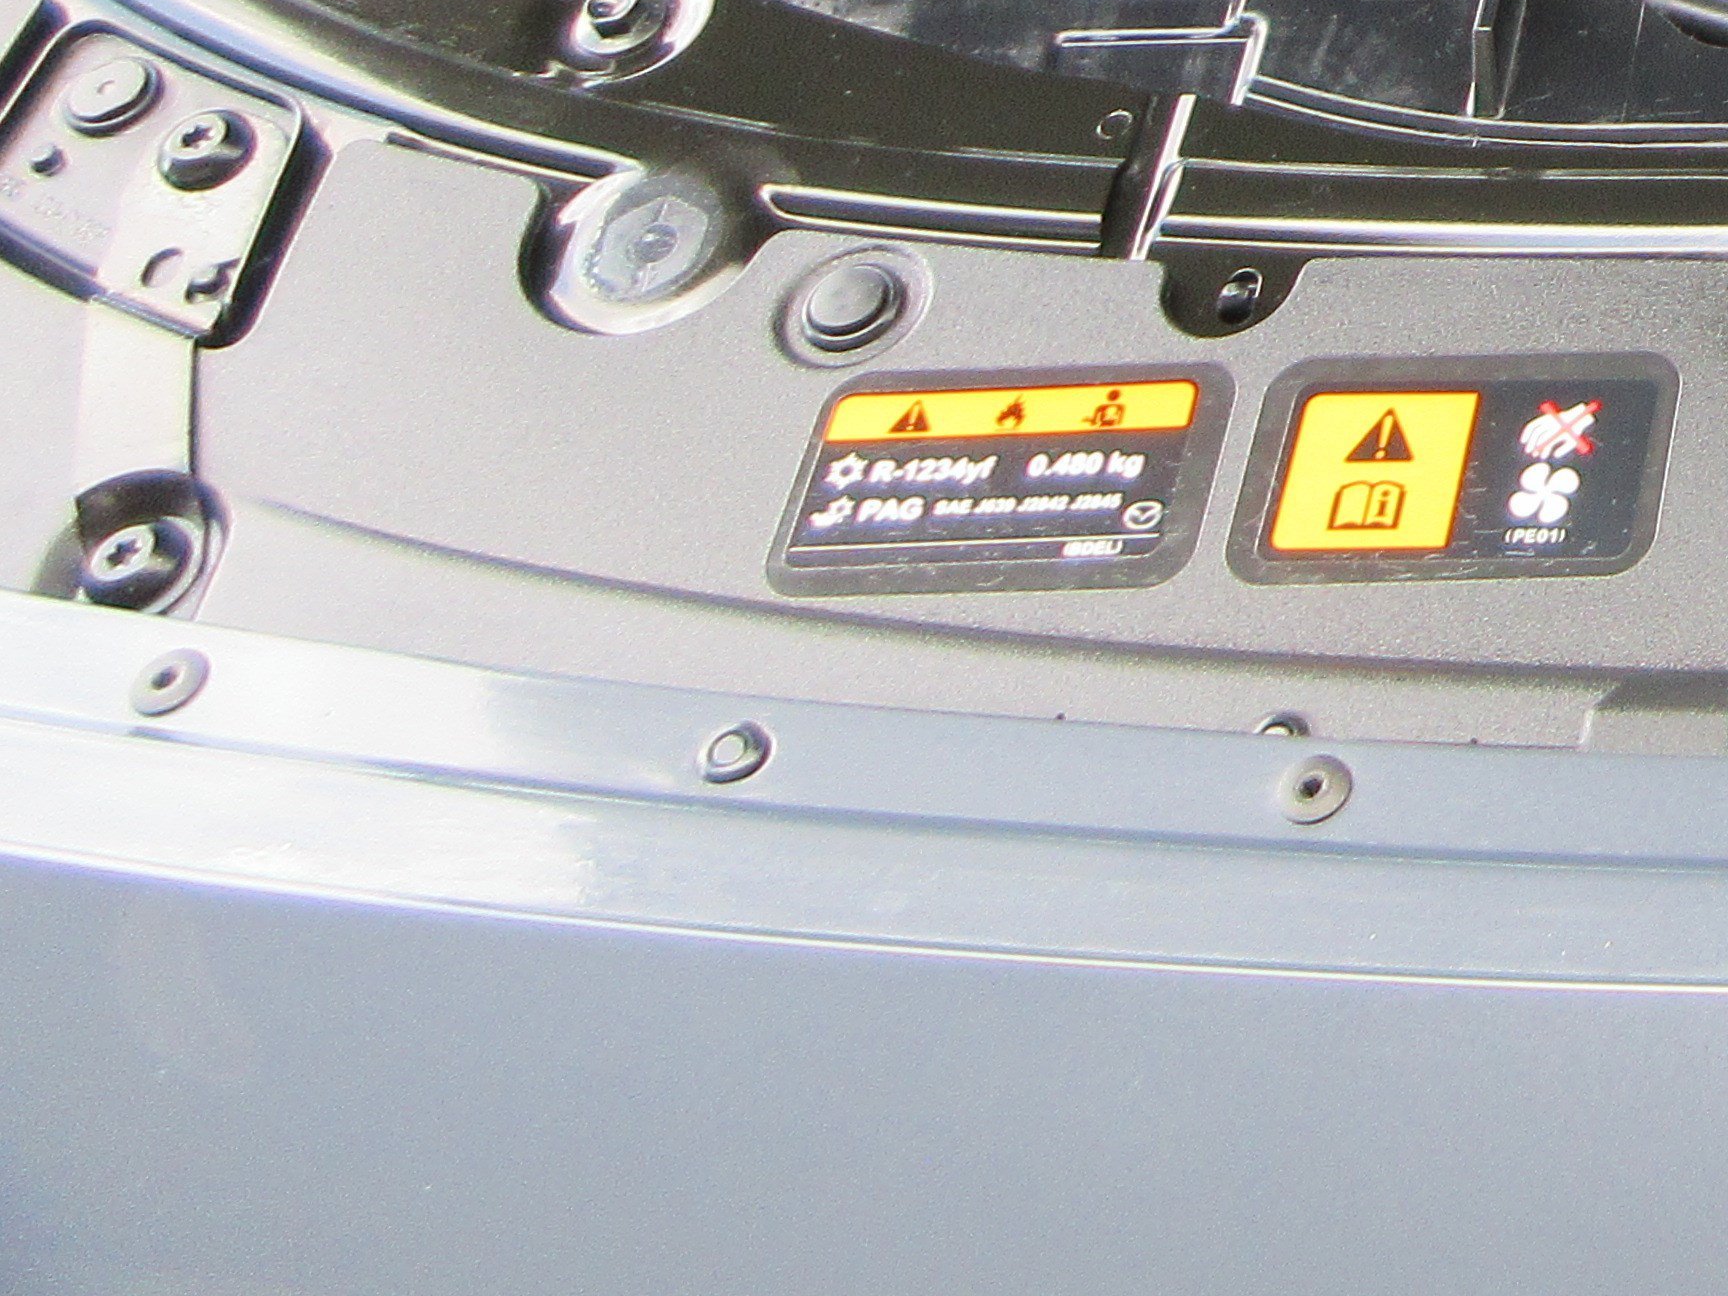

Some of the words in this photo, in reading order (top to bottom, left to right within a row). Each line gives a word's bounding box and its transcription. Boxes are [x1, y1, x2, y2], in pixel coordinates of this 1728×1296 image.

[869, 455, 998, 485] R-1234yf
[1106, 449, 1146, 479] kg
[855, 495, 925, 522] PAG
[1503, 527, 1567, 545] (PE01)
